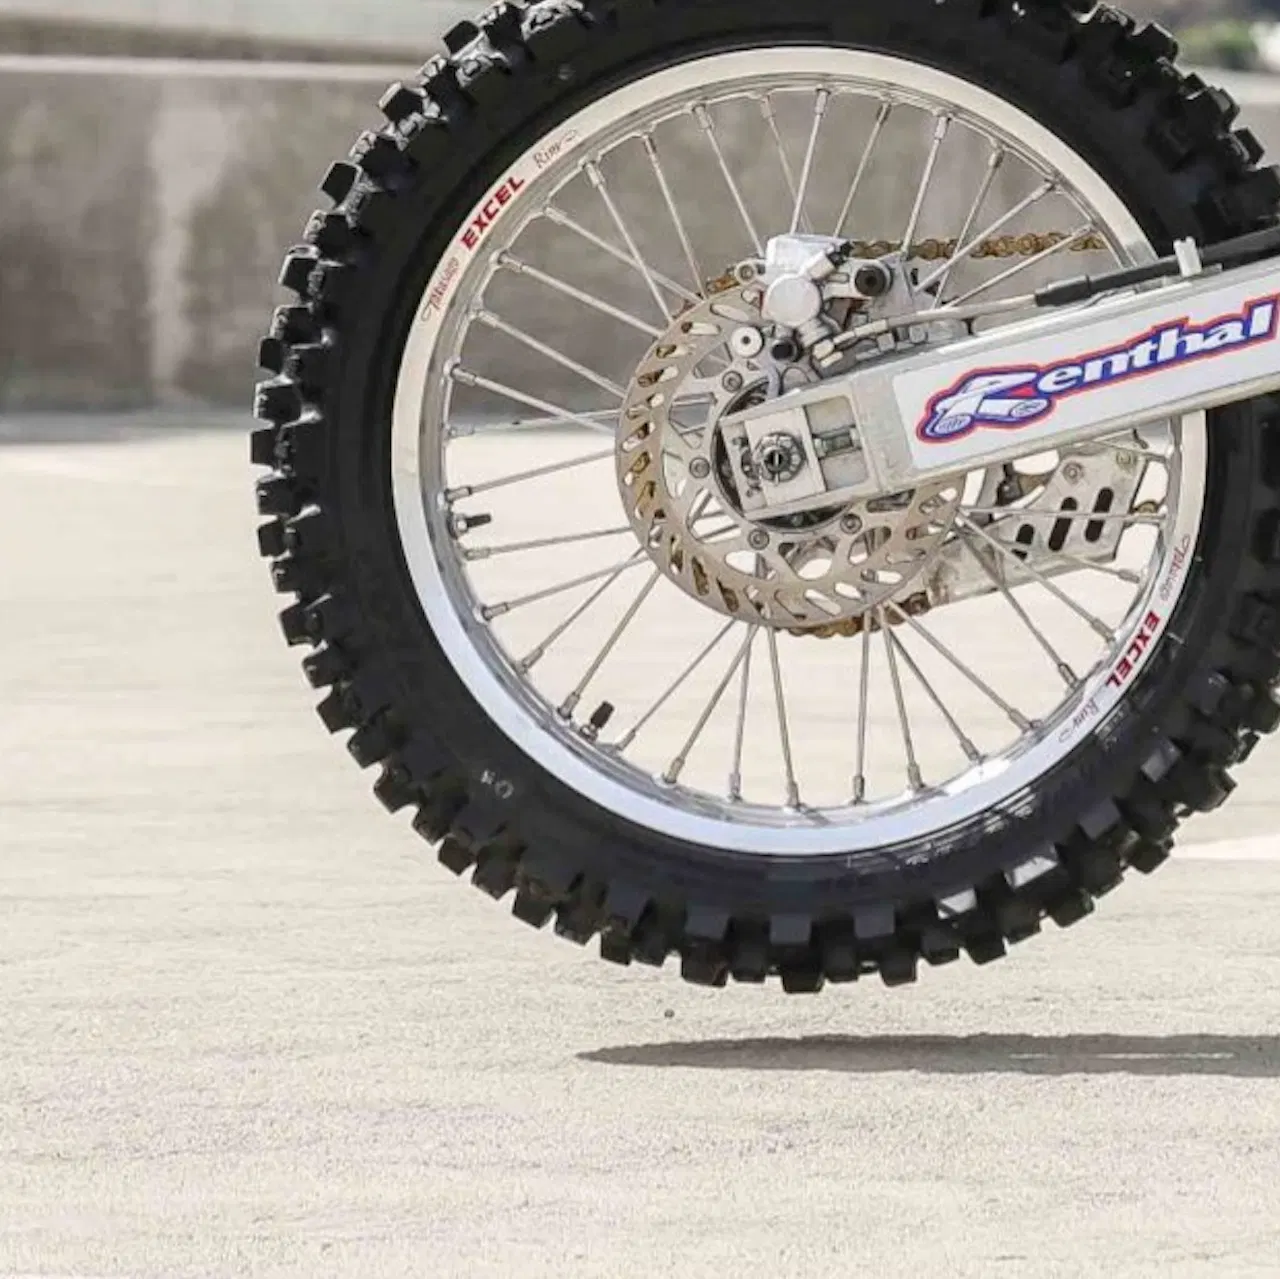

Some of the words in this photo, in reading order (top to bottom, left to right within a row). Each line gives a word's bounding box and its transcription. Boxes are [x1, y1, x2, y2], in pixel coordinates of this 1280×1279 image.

[460, 176, 525, 250] EXCEL
[921, 297, 1279, 439] Renthal
[1106, 610, 1161, 687] EXCEL
